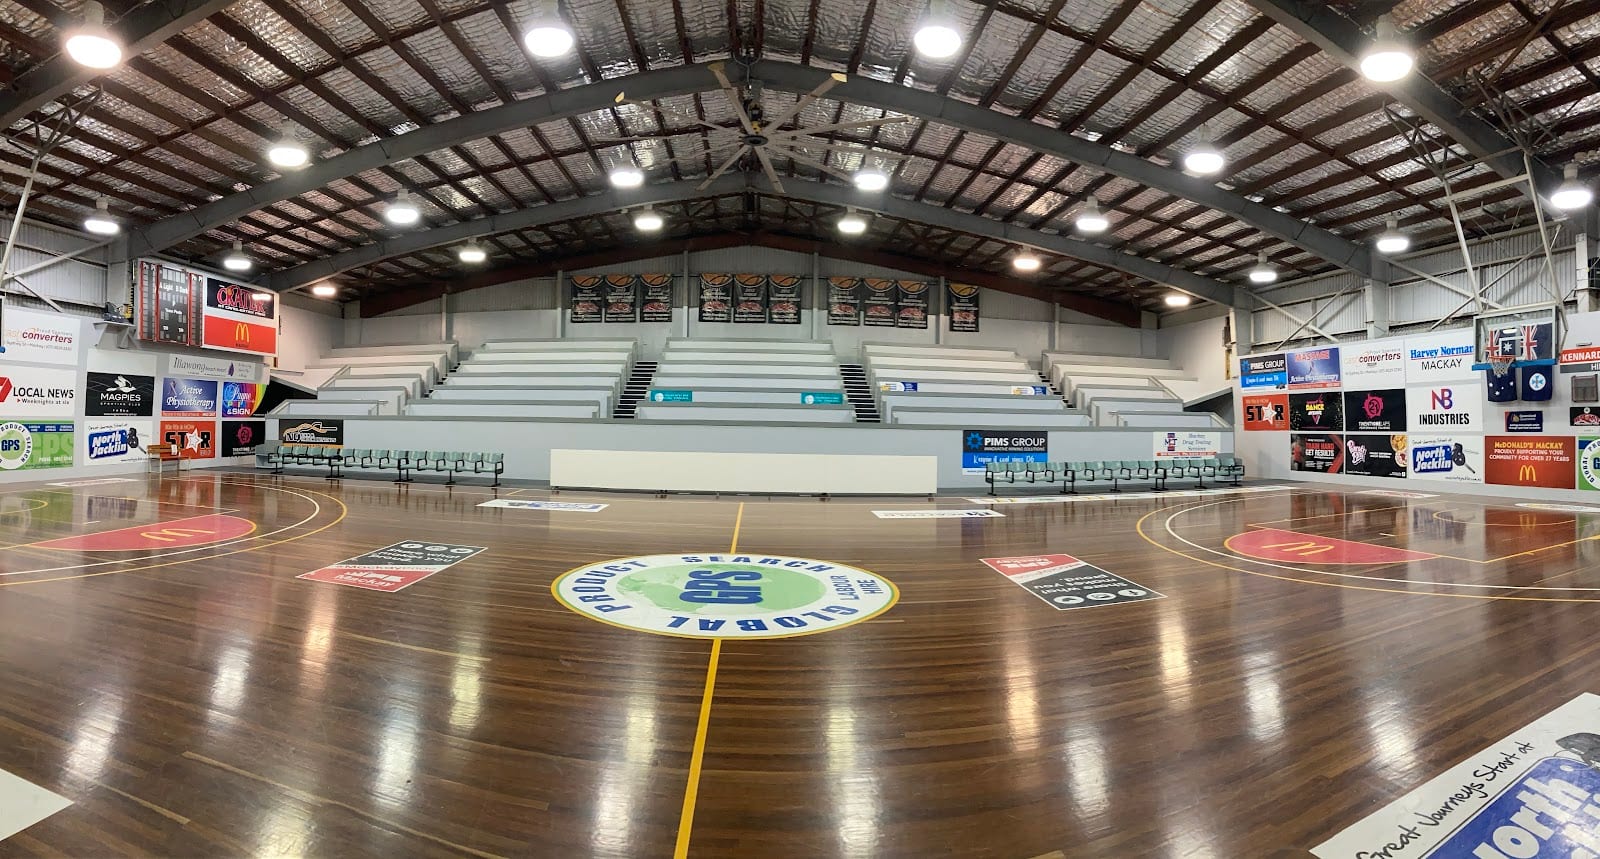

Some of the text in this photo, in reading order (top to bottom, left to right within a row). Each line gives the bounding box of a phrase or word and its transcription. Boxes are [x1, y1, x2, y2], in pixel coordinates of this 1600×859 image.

[22, 331, 73, 343] converters
[1359, 353, 1401, 363] converters
[1410, 348, 1438, 358] Harvey
[1265, 360, 1285, 368] GROUP
[1421, 359, 1462, 370] MACKAY
[13, 386, 74, 398] LOCAL NEWS
[100, 393, 141, 401] MAGPIES
[179, 385, 203, 395] Active
[166, 395, 214, 409] Physiotherapy
[1432, 388, 1453, 410] NB
[1419, 413, 1470, 425] INDUSTRIES
[1, 439, 20, 451] GPS
[92, 431, 121, 448] North
[984, 438, 1046, 446] PIMS GROUP
[91, 441, 126, 457] Jacklin
[1416, 447, 1445, 461] North
[1415, 457, 1451, 472] Jacklin
[681, 555, 834, 573] SEARCH
[572, 560, 648, 614] PRODUCT
[679, 569, 763, 605] GPS
[830, 575, 860, 601] LABOUR
[856, 579, 884, 595] HIRE
[665, 605, 859, 632] GLOBAL
[1414, 783, 1489, 826] Journeys
[1473, 752, 1520, 781] Start
[1514, 741, 1535, 754] at
[1472, 777, 1592, 859] orth
